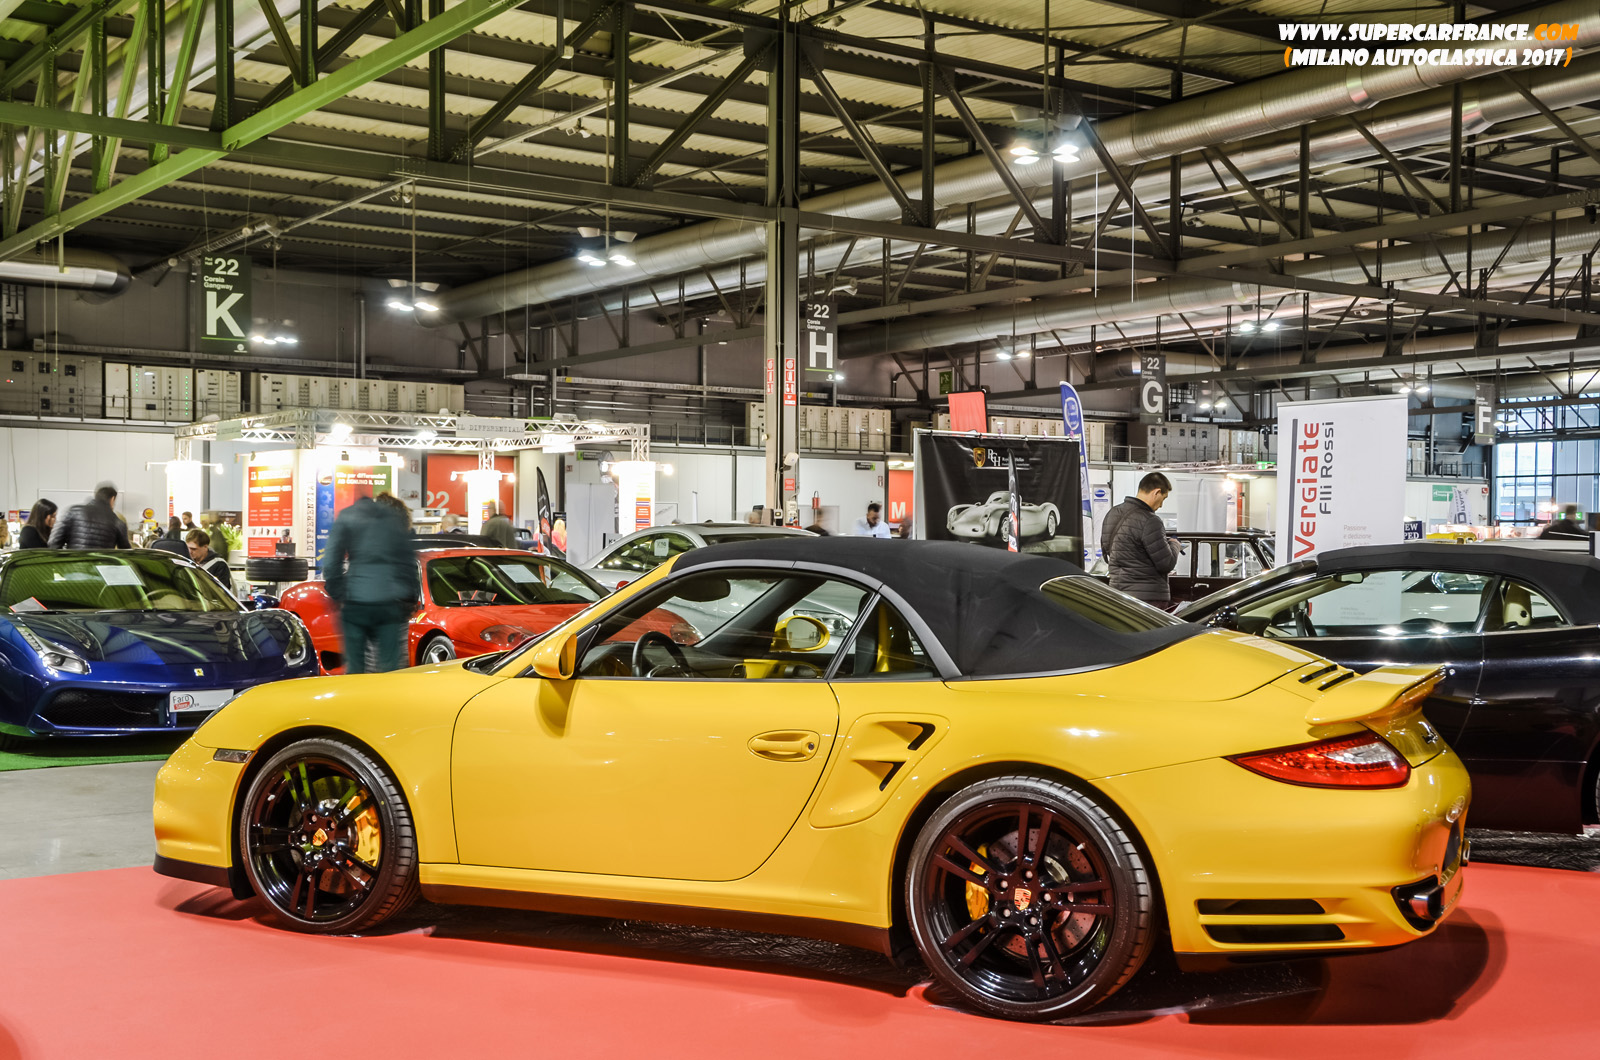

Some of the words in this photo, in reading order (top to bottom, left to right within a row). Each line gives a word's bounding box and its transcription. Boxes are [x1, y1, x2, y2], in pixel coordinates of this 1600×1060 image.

[214, 257, 240, 276] 22
[203, 275, 226, 283] Corsia
[203, 281, 234, 291] Gangway
[206, 290, 246, 338] K
[813, 303, 830, 319] 22
[809, 331, 834, 369] H
[1147, 357, 1160, 370] 22
[1142, 380, 1163, 414] G
[1478, 405, 1492, 434] F
[1320, 421, 1334, 479] Rossi
[891, 501, 906, 520] M
[172, 695, 190, 704] Faro
